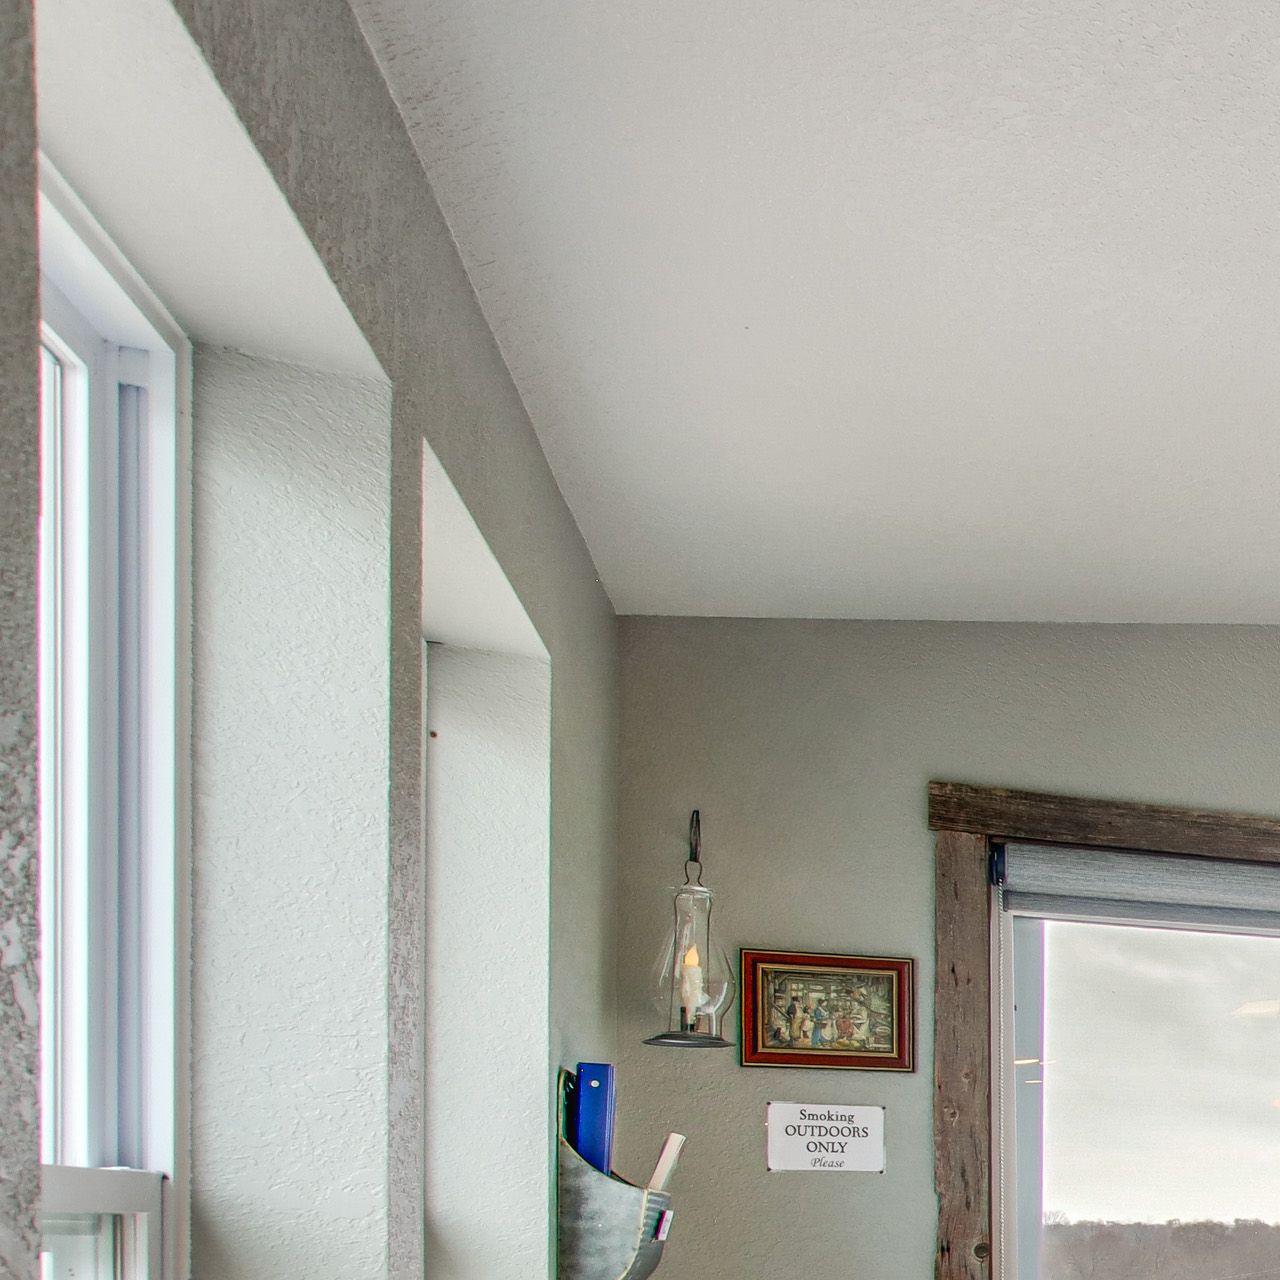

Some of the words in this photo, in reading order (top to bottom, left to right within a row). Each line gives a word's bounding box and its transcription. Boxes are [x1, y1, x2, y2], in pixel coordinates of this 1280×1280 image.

[799, 1108, 855, 1124] Smoking
[785, 1124, 869, 1138] OUTDOORS
[806, 1141, 848, 1153] ONLY
[811, 1156, 845, 1168] Please
